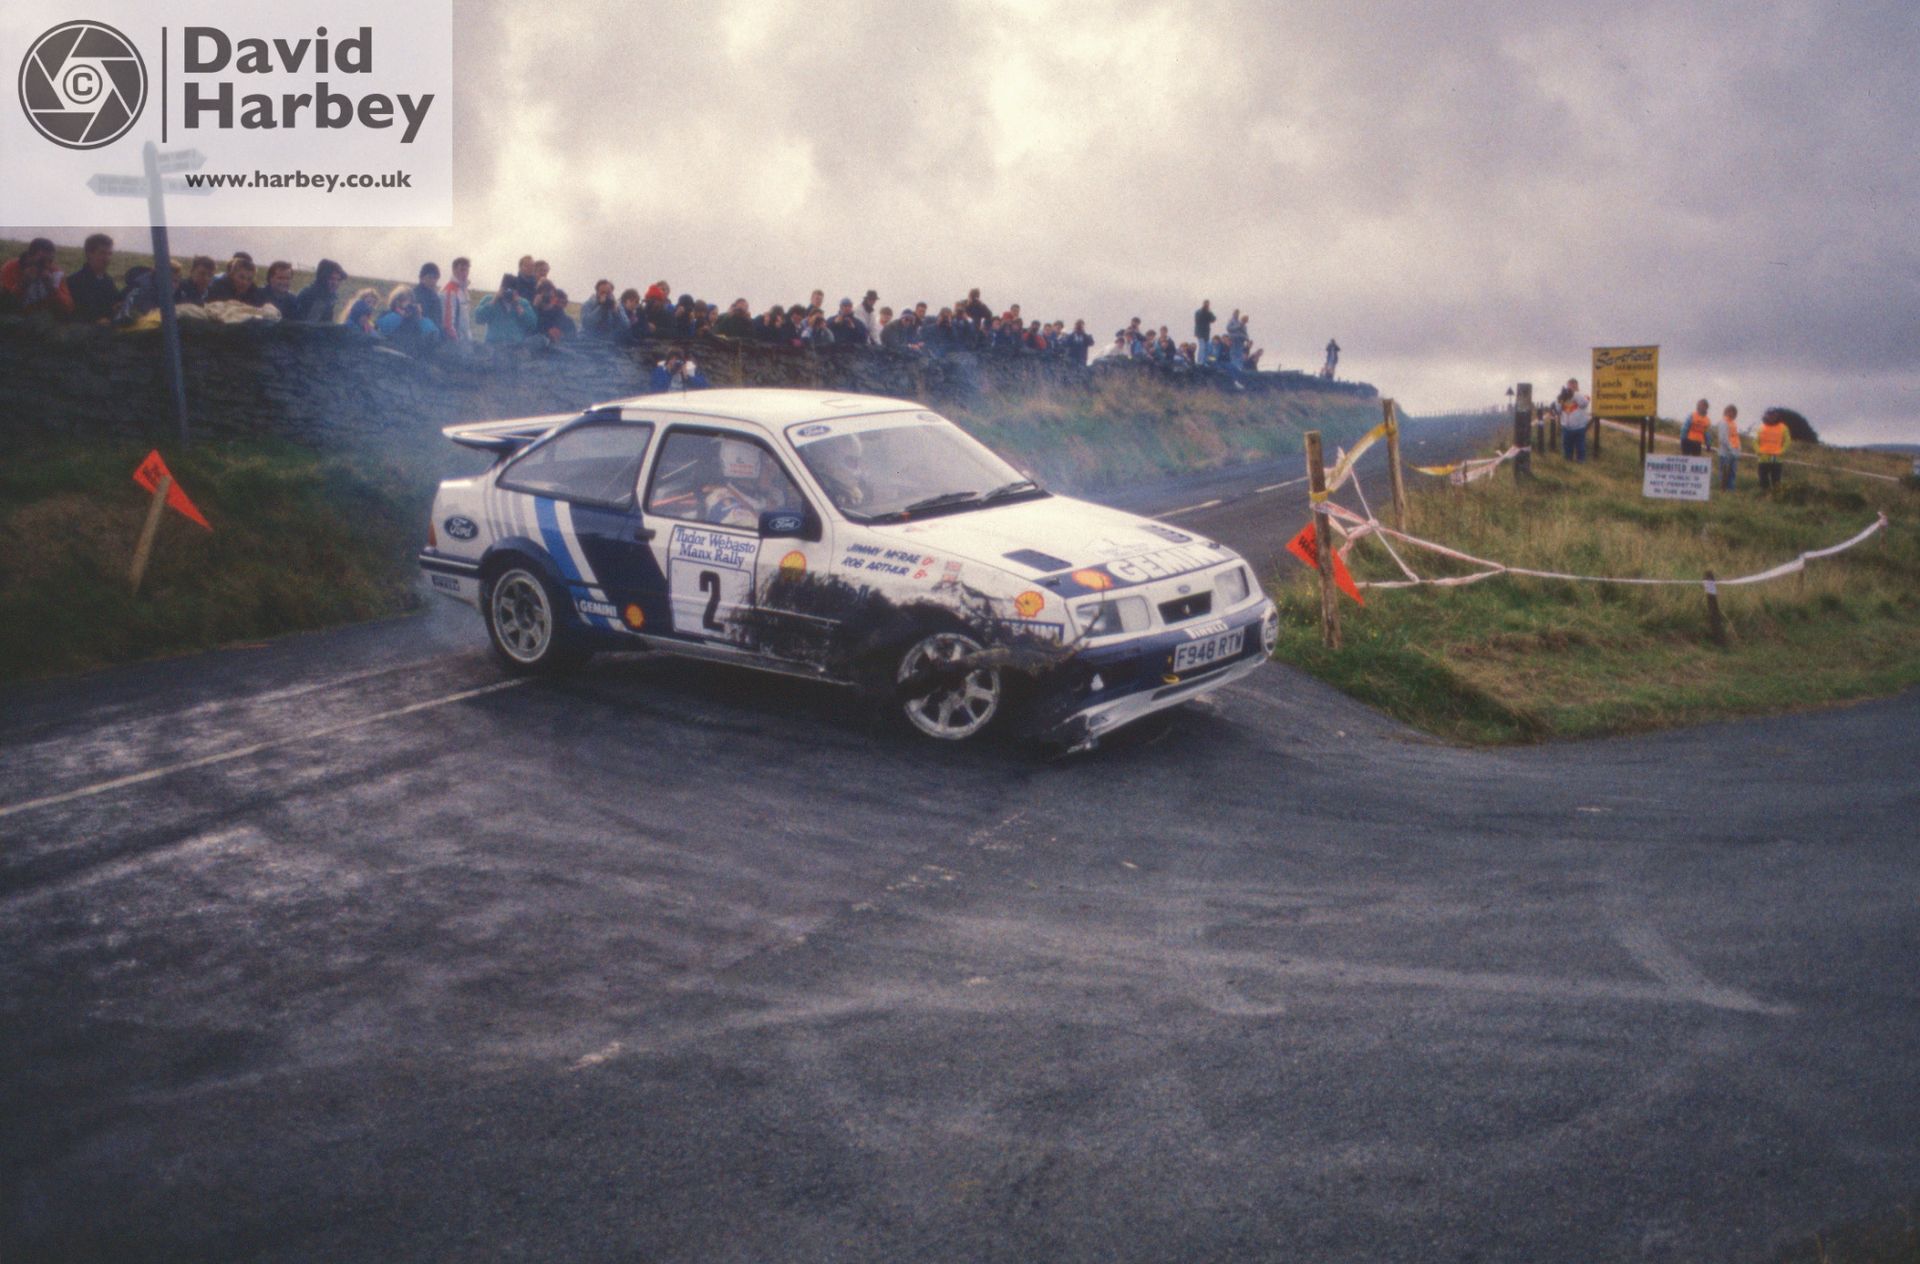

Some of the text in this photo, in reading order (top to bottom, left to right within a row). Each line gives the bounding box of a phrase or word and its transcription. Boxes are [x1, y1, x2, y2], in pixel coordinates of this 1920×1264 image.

[1647, 462, 1708, 474] PROHIBITED AREA
[676, 527, 756, 554] Tudor Webasto
[846, 543, 884, 556] JIMMY
[679, 543, 745, 569] Manx Rally
[841, 556, 865, 569] ROB
[865, 561, 910, 576] ARTHUR
[700, 570, 725, 632] 2
[1176, 640, 1216, 667] F948
